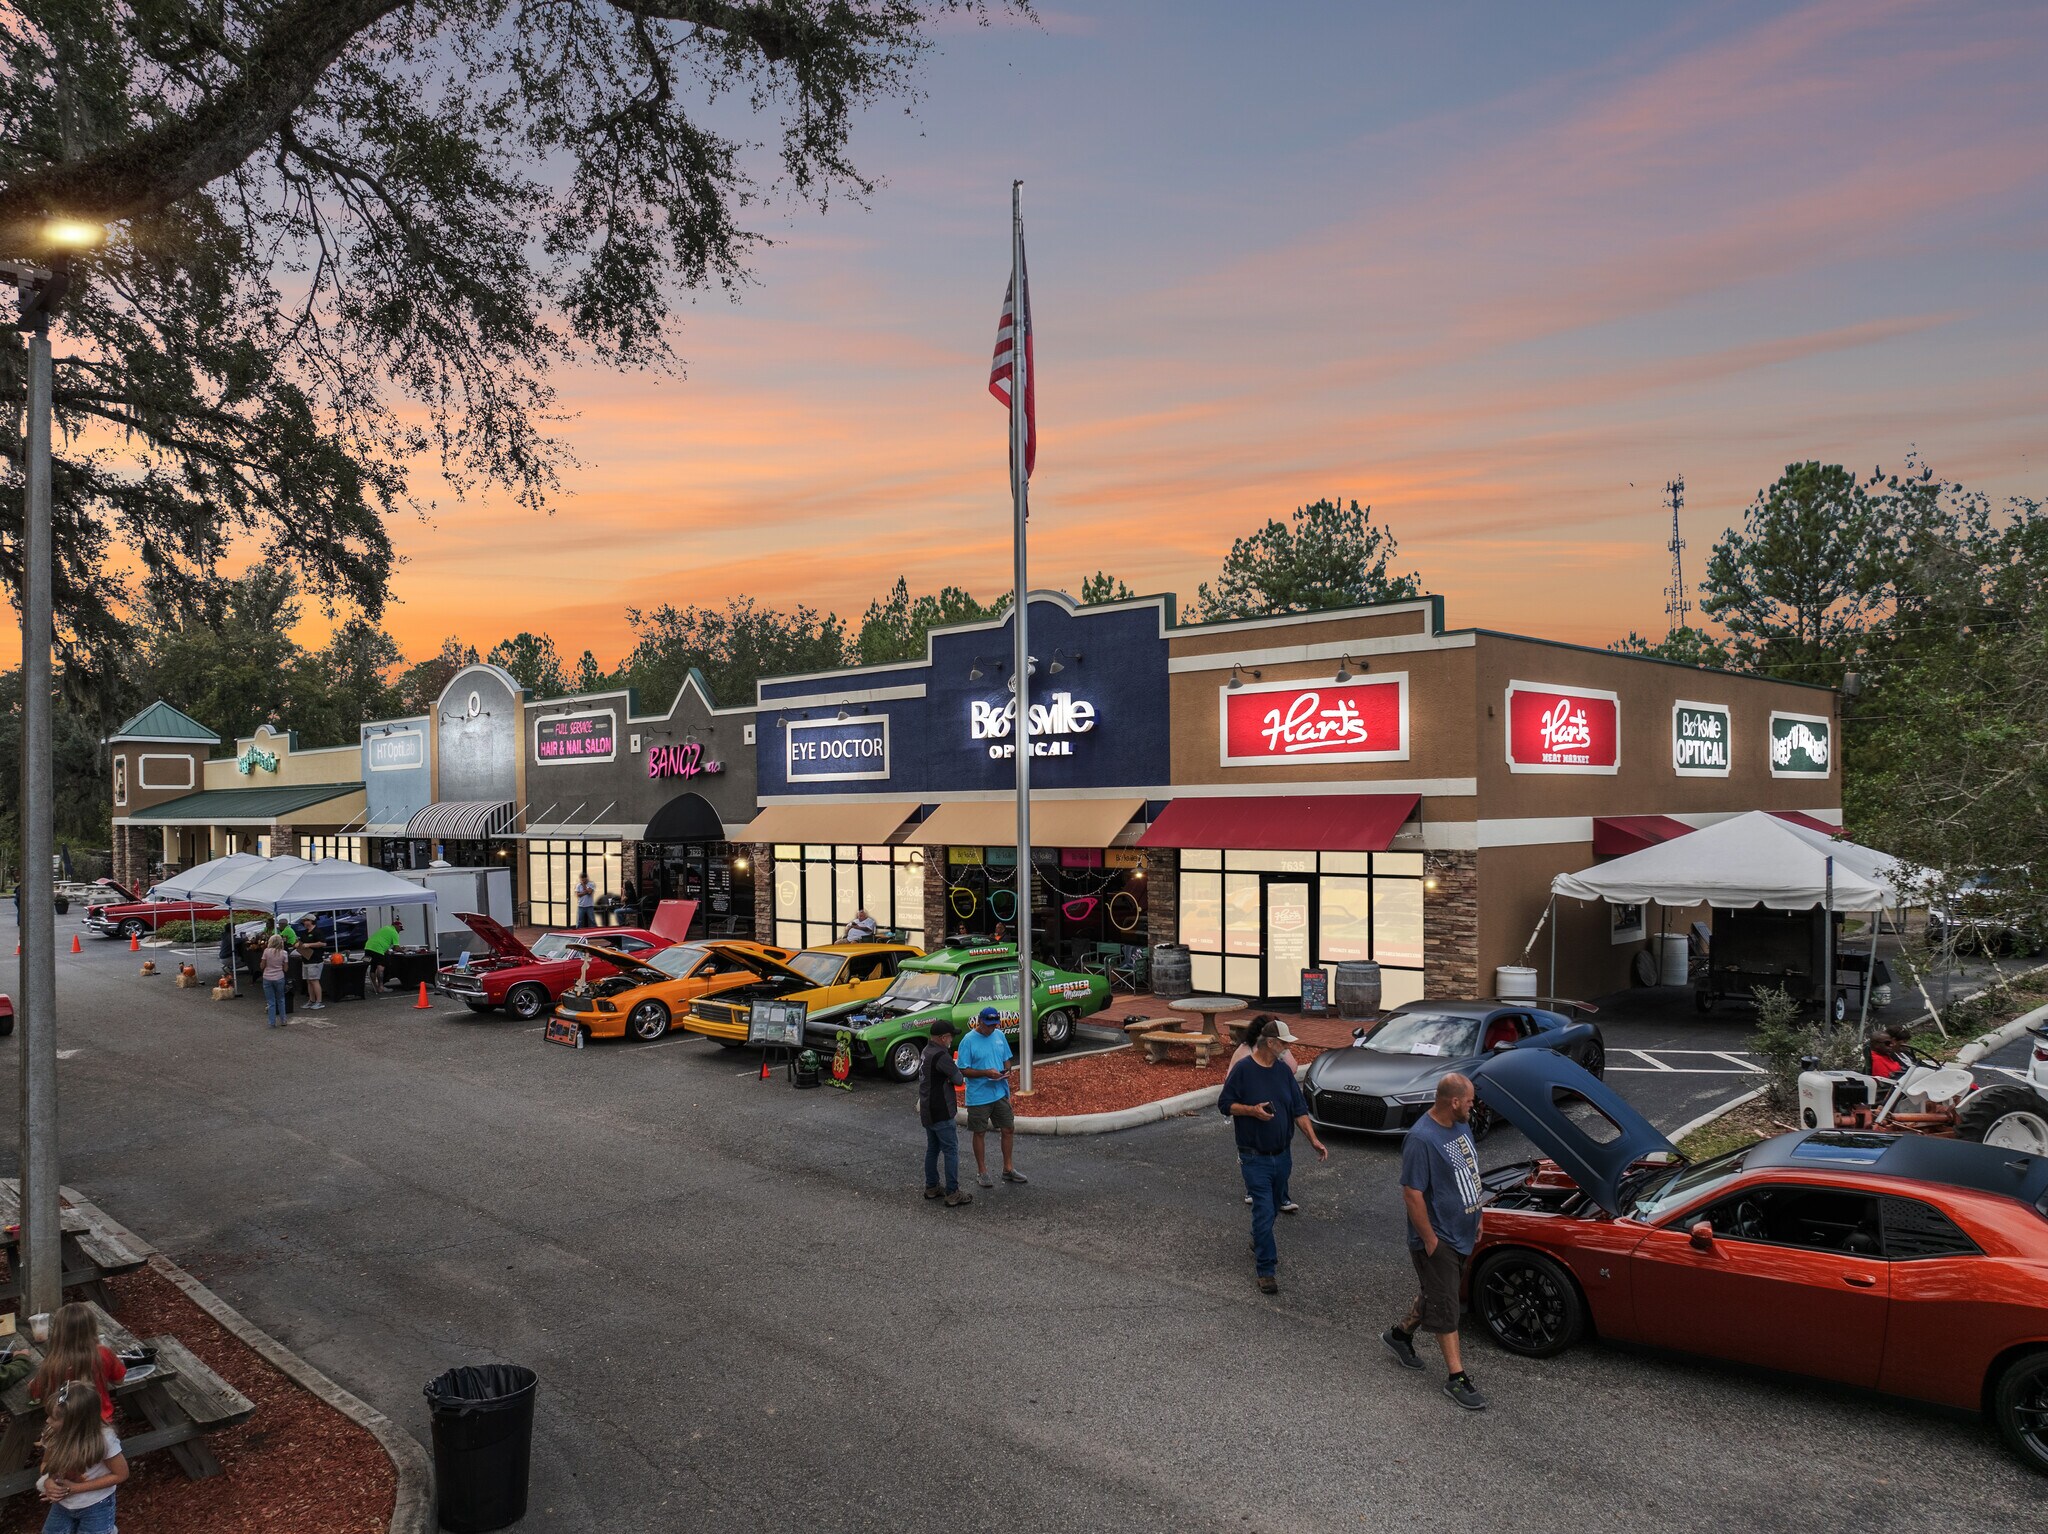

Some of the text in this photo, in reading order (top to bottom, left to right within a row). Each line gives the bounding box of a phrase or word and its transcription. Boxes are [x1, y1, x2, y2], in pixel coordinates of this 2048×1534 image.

[971, 692, 1095, 739] Broosville
[1261, 692, 1368, 753] Hart's
[1540, 698, 1591, 752] Hart's
[555, 720, 593, 736] FULL SERVICE
[376, 741, 415, 761] HT OptiLab
[540, 737, 612, 756] HAIR & NAIL SALON
[792, 738, 883, 760] EYE DOCTOR
[989, 741, 1073, 759] OPICAL
[1676, 738, 1726, 765] OPTICAL
[1542, 753, 1590, 764] MEAT MARKET
[1280, 861, 1305, 871] 7635
[969, 947, 1009, 957] SHAGNASTY
[1048, 980, 1090, 995] WEBSTER
[1457, 1136, 1469, 1155] DAD
[1466, 1157, 1474, 1169] OF
